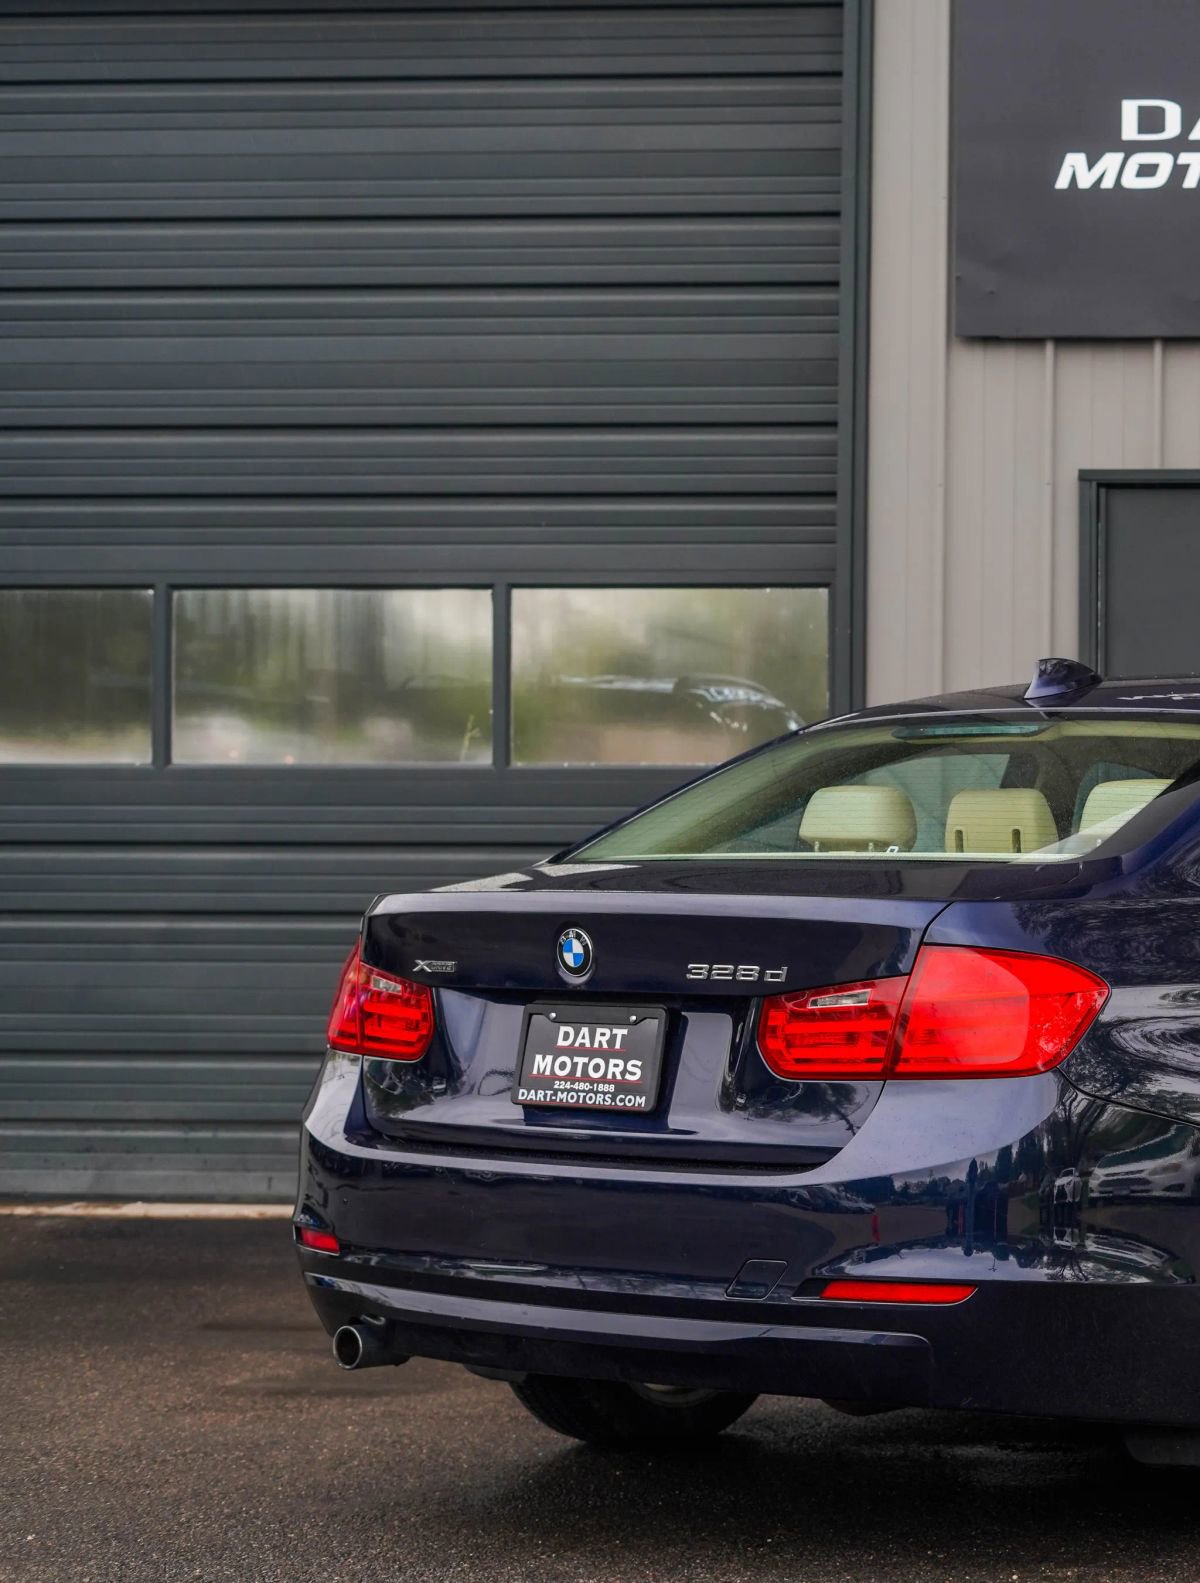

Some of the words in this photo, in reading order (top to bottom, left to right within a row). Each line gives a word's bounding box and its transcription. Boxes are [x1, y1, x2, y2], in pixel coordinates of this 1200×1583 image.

[556, 1026, 629, 1049] DART
[532, 1054, 643, 1081] MOTORS
[553, 1081, 615, 1092] 224-480-1888
[518, 1089, 646, 1107] DART-MOTORS.COM
